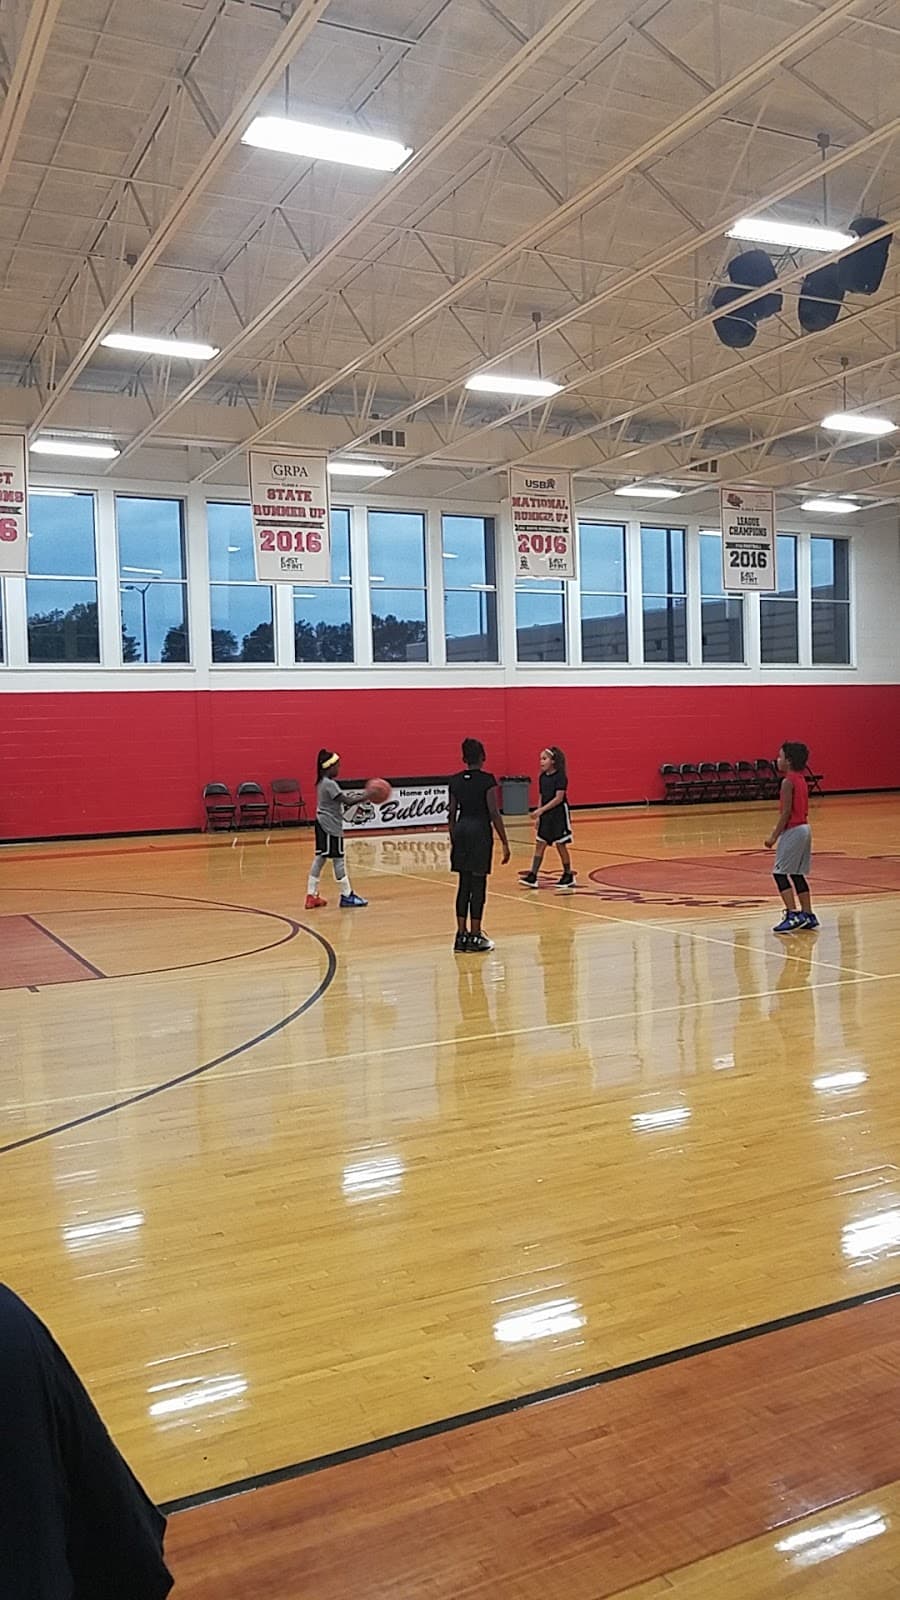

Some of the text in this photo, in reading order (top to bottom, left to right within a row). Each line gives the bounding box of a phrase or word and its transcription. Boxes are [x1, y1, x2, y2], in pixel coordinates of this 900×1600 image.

[273, 464, 309, 478] GRPA
[525, 479, 556, 489] USBA
[267, 488, 313, 502] STATE
[512, 496, 569, 510] NATIONAL
[253, 504, 326, 519] RUNNER UP
[736, 516, 760, 527] LEAGUE
[728, 526, 767, 537] CHAMPIONS
[260, 529, 322, 553] 2016
[517, 534, 568, 554] 2016
[729, 550, 767, 569] 2016
[400, 787, 446, 797] Home of the
